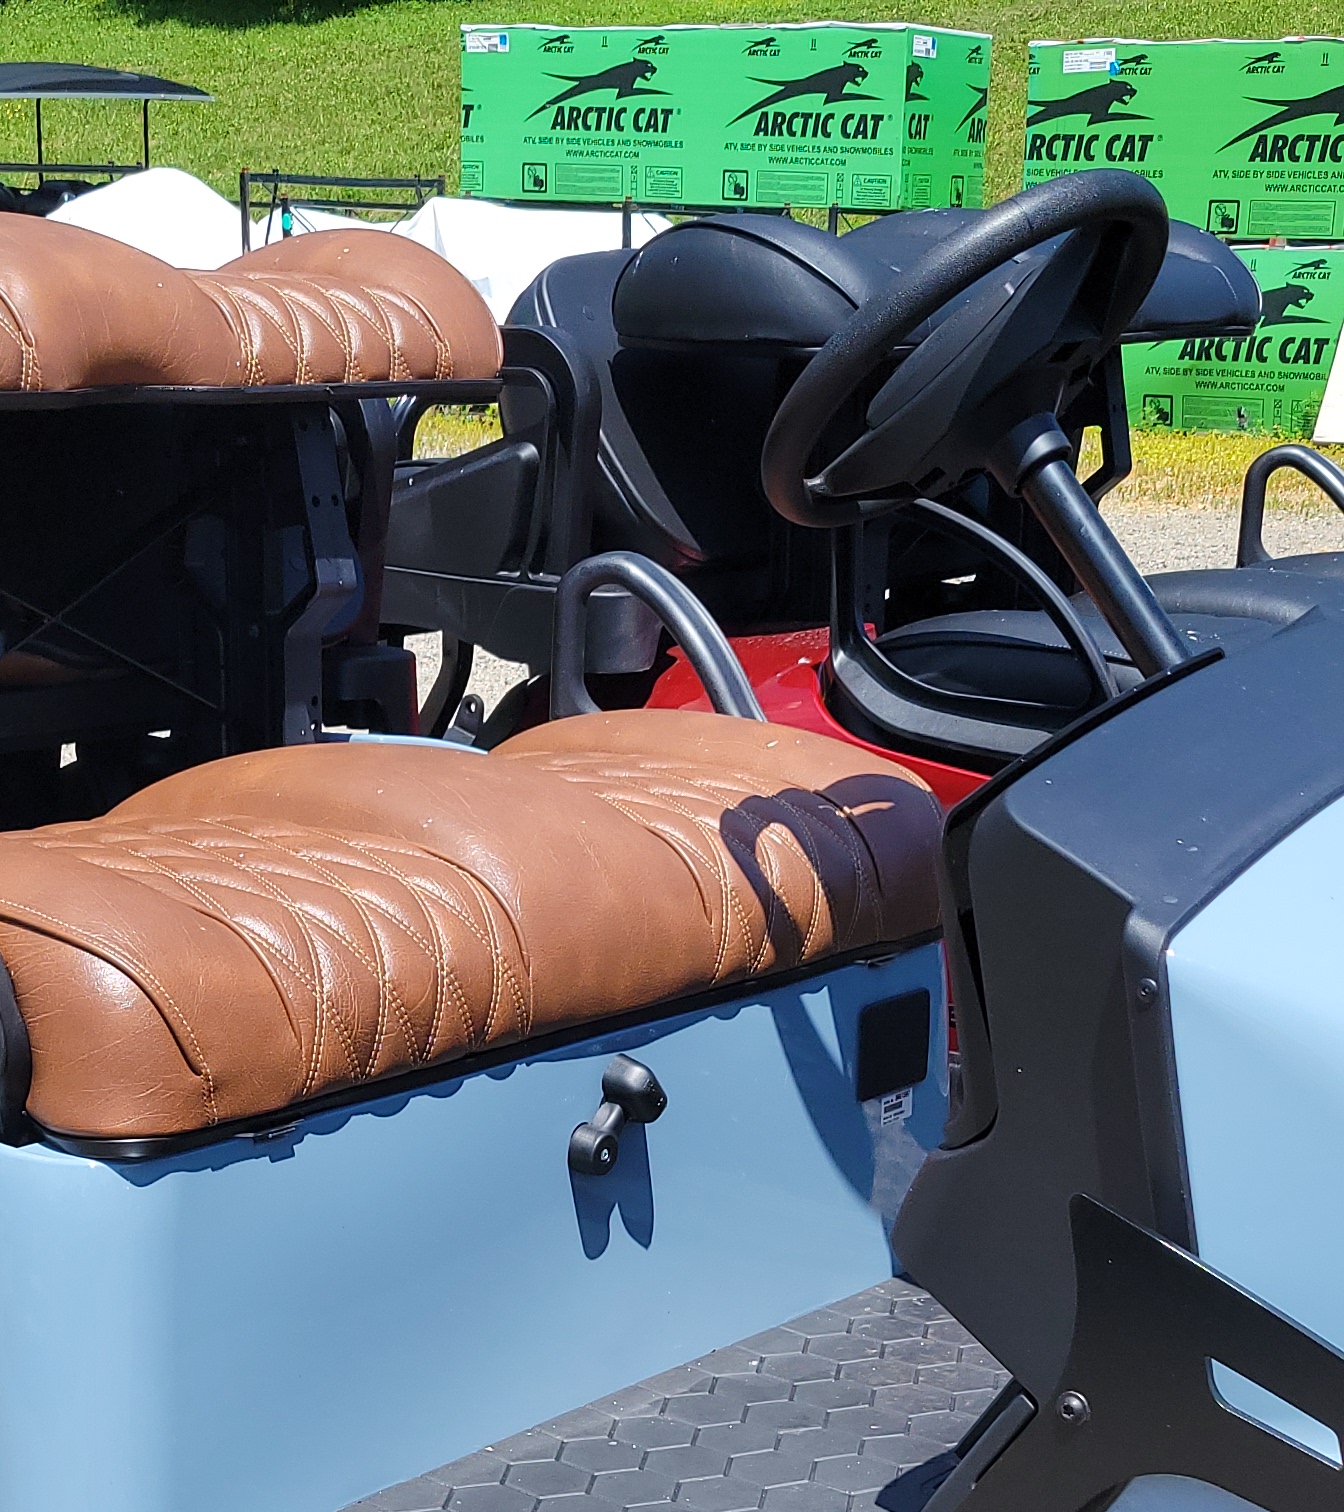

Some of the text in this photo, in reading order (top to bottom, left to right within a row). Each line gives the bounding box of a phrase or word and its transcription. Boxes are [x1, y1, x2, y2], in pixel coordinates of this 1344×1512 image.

[1246, 65, 1285, 74] ARCTIC CAT
[550, 106, 674, 133] ARCTIC CAT
[753, 111, 884, 140] ARCTIC CAT
[908, 113, 930, 140] CAT
[740, 143, 755, 151] SIDE
[769, 144, 785, 152] SIDE
[786, 145, 821, 153] VEHICLES
[840, 147, 893, 156] SNOWMOBILES
[1106, 134, 1155, 162] CAT
[1026, 168, 1045, 177] SIDE
[1212, 170, 1230, 180] ATV,
[1232, 170, 1251, 179] SIDE
[1253, 170, 1265, 179] BY
[1266, 170, 1286, 179] SIDE
[1287, 170, 1329, 179] VEHICLES
[1292, 272, 1330, 280] ARCTIC CAT
[1178, 336, 1330, 365] ARCTIC CAT
[1163, 367, 1180, 376] SIDE
[1183, 368, 1193, 376] BY
[1195, 368, 1214, 377] SIDE
[1215, 369, 1255, 378] VEHICLES
[1258, 370, 1275, 379] AND
[1195, 381, 1285, 393] WWW.ARCTICCAT.COM
